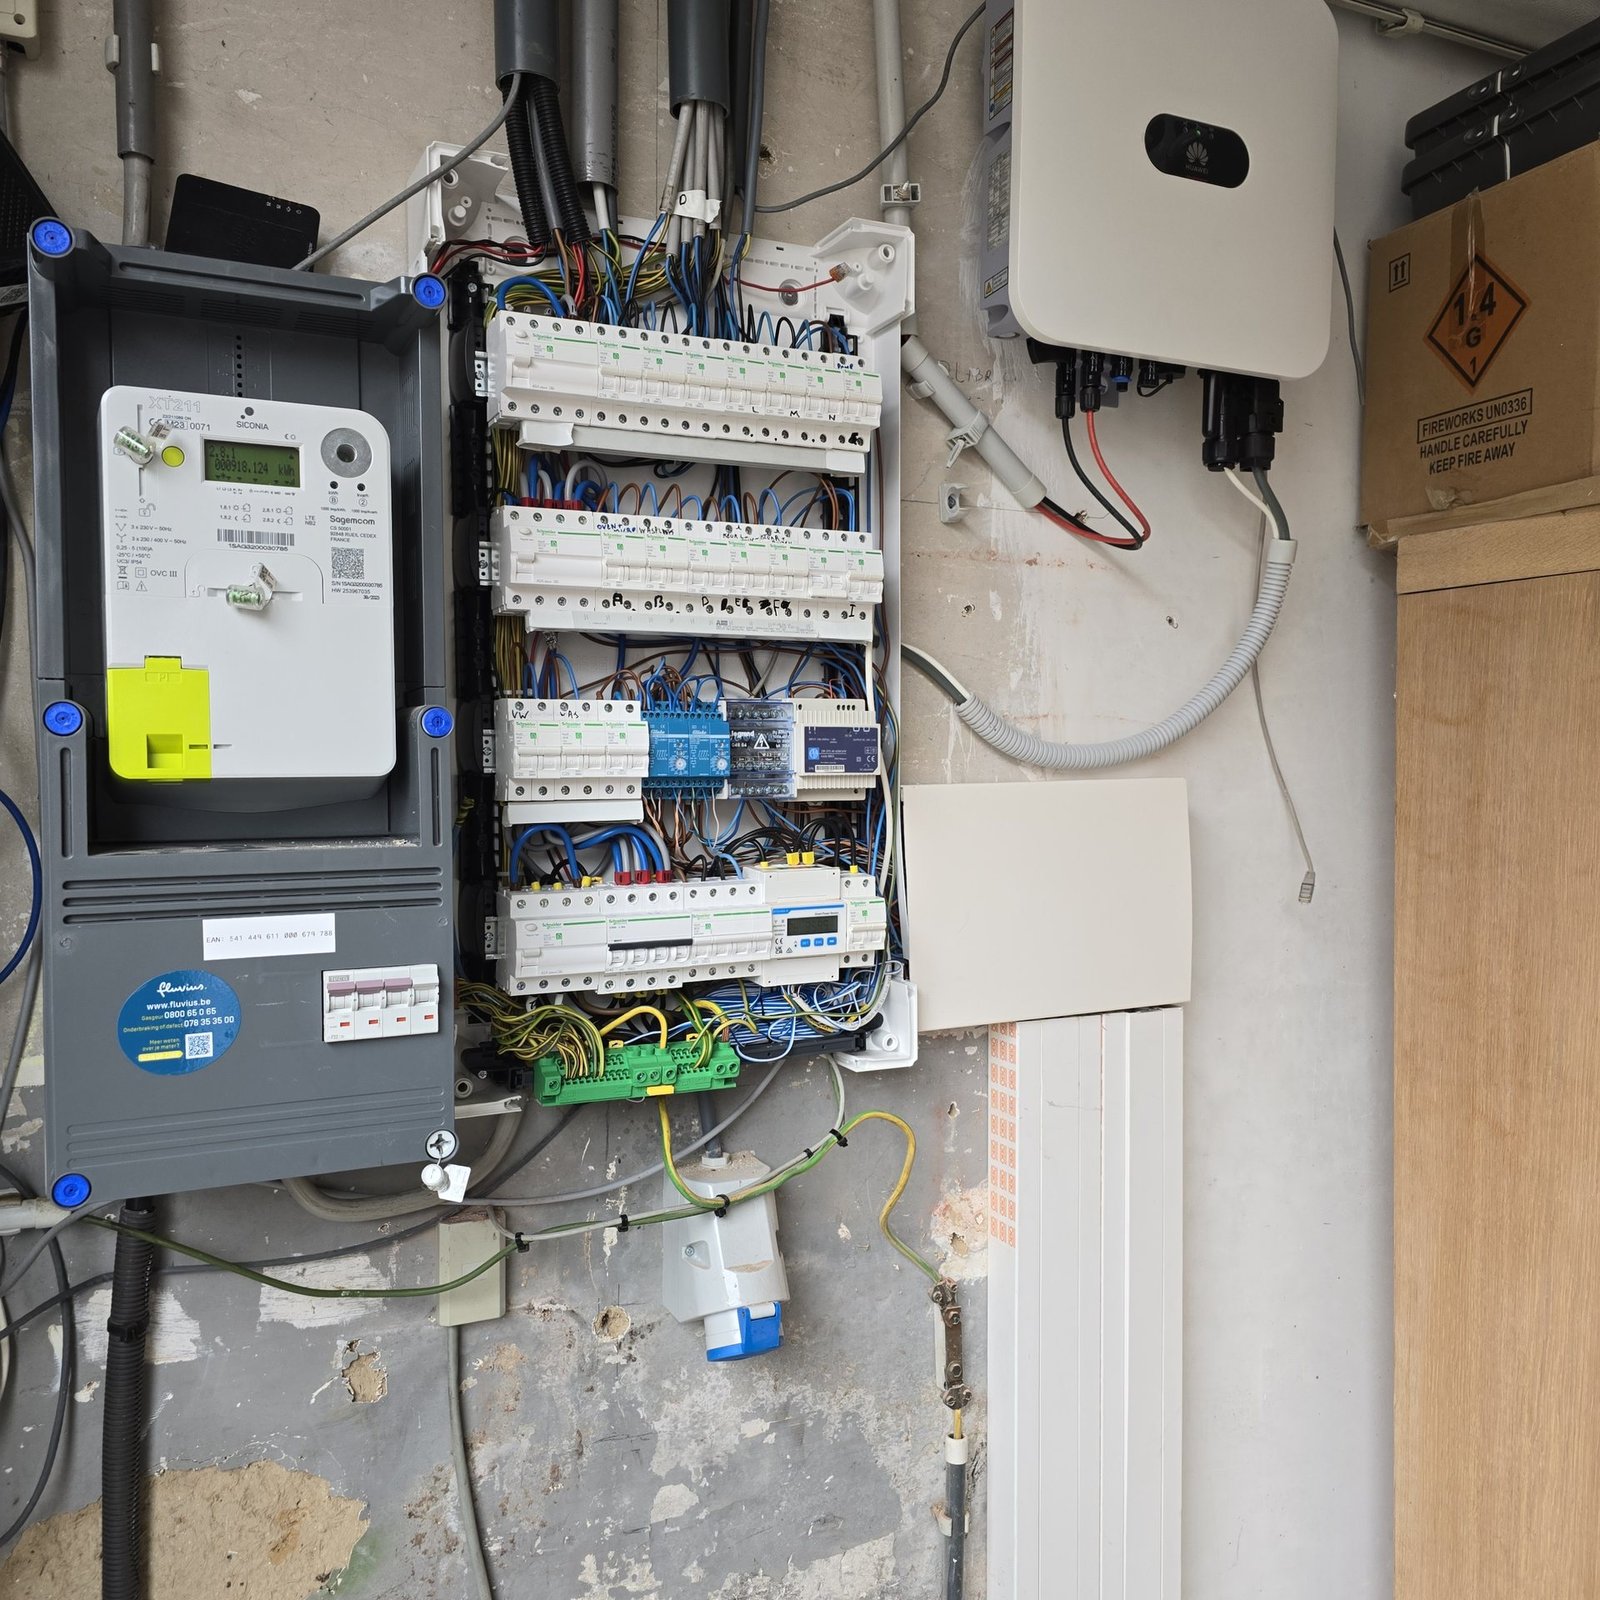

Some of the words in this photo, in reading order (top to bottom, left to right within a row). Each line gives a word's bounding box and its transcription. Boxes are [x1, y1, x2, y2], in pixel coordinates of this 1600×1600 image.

[1466, 327, 1481, 348] G
[1469, 357, 1477, 374] 1
[148, 396, 201, 413] XT211
[1422, 408, 1483, 437] FIREWORKS
[1486, 396, 1527, 421] UN0336
[190, 423, 211, 431] 0071
[236, 421, 269, 430] SICONIA
[1420, 436, 1461, 459] HANDLE
[1462, 419, 1528, 449] CAREFULLY
[209, 445, 236, 459] 2.8.1
[1429, 455, 1456, 475] KEEP
[1457, 449, 1482, 469] FIRE
[1484, 442, 1516, 463] AWAY
[214, 458, 269, 475] 000918.124
[278, 464, 295, 476] kWh
[330, 515, 375, 525] Sagemcom
[612, 592, 623, 607] A
[654, 595, 664, 608] B
[157, 982, 207, 998] fluvius.
[146, 999, 211, 1010] www.fluvius.be
[164, 1010, 185, 1019] 0800
[187, 1009, 198, 1017] 65
[199, 1008, 205, 1016] 0
[206, 1007, 217, 1015] 65
[123, 1025, 158, 1033] Onderbraking
[183, 1019, 199, 1028] 078
[201, 1017, 211, 1026] 35
[212, 1016, 223, 1024] 35
[224, 1015, 235, 1024] 00
